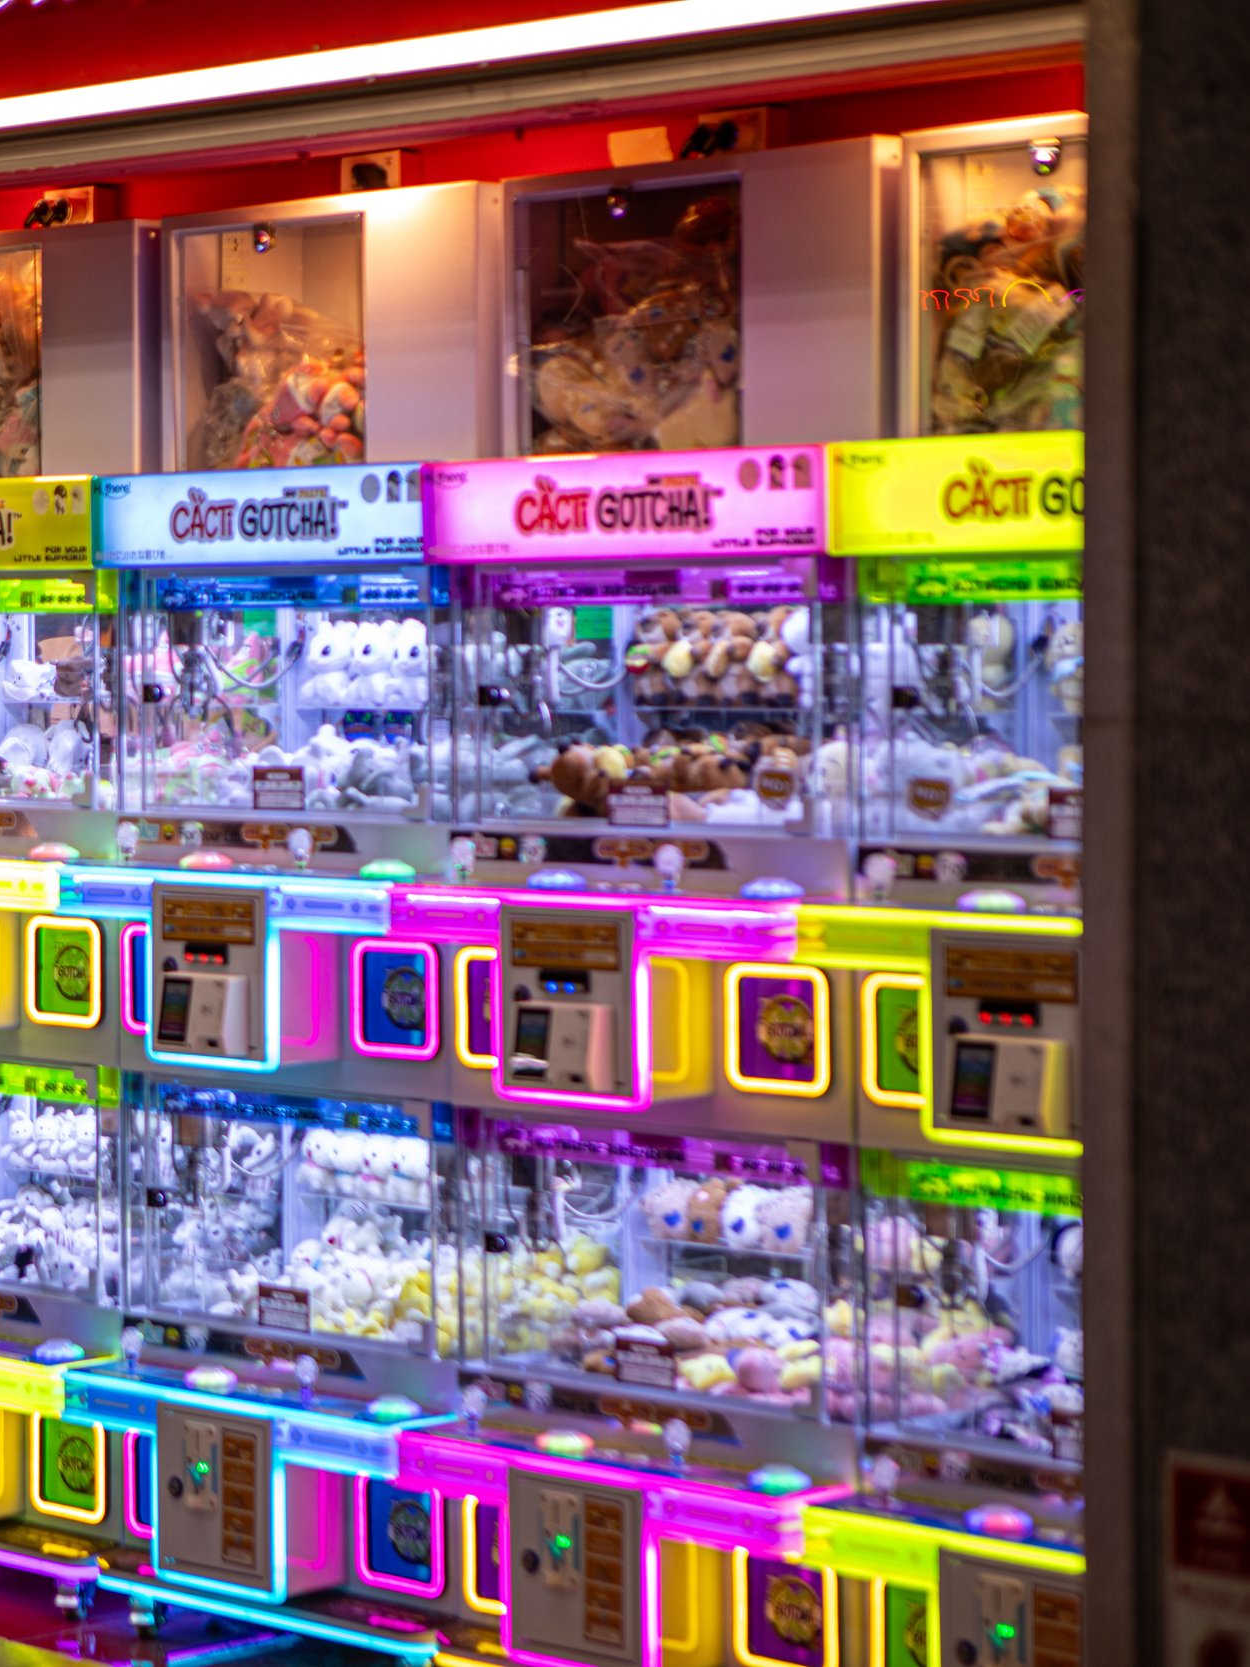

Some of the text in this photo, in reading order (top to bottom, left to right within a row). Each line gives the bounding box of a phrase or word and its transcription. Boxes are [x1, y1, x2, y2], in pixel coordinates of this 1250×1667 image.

[597, 489, 712, 529] GOTCHA!
[239, 500, 338, 538] GOTCHA!
[65, 546, 87, 554] YOUR
[337, 548, 369, 556] LITTLE
[45, 554, 88, 562] EUPHORIA
